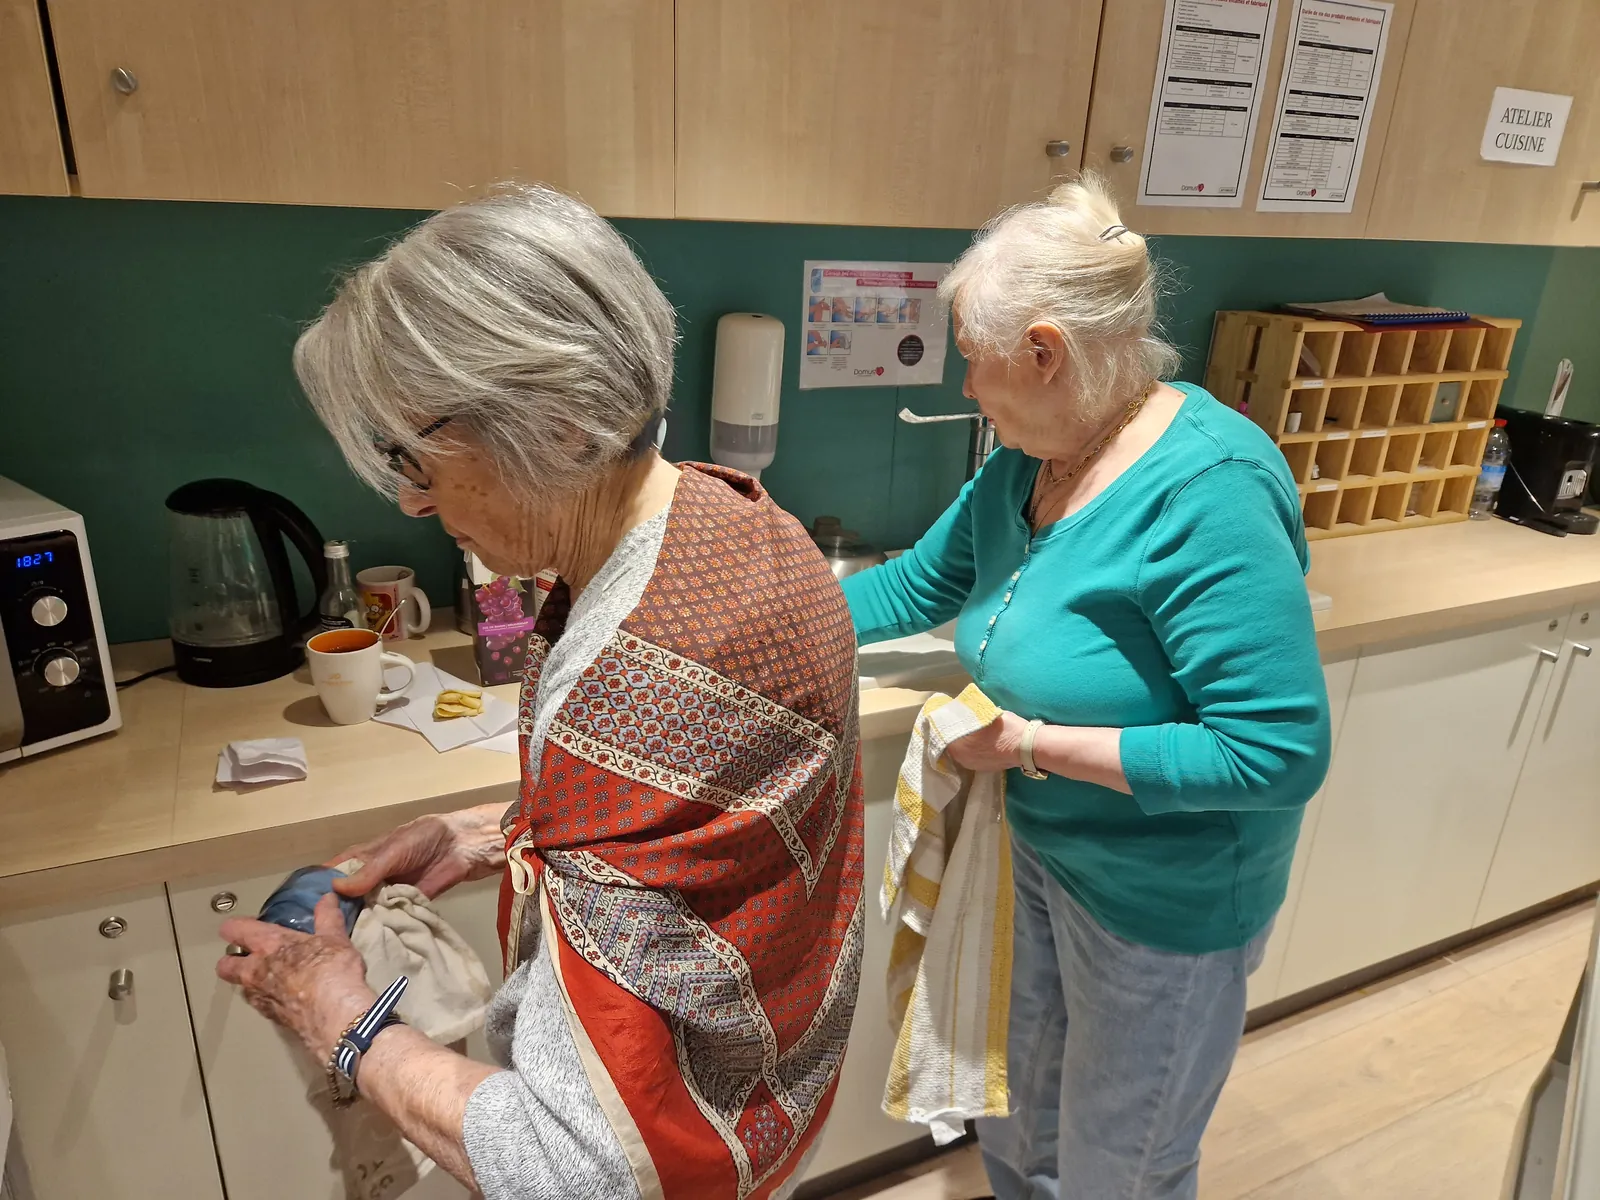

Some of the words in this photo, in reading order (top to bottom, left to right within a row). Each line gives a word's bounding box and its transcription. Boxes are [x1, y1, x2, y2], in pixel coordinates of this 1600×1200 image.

[1500, 107, 1553, 128] ATELIER
[1495, 132, 1547, 152] CUISINE
[16, 552, 54, 568] 1827
